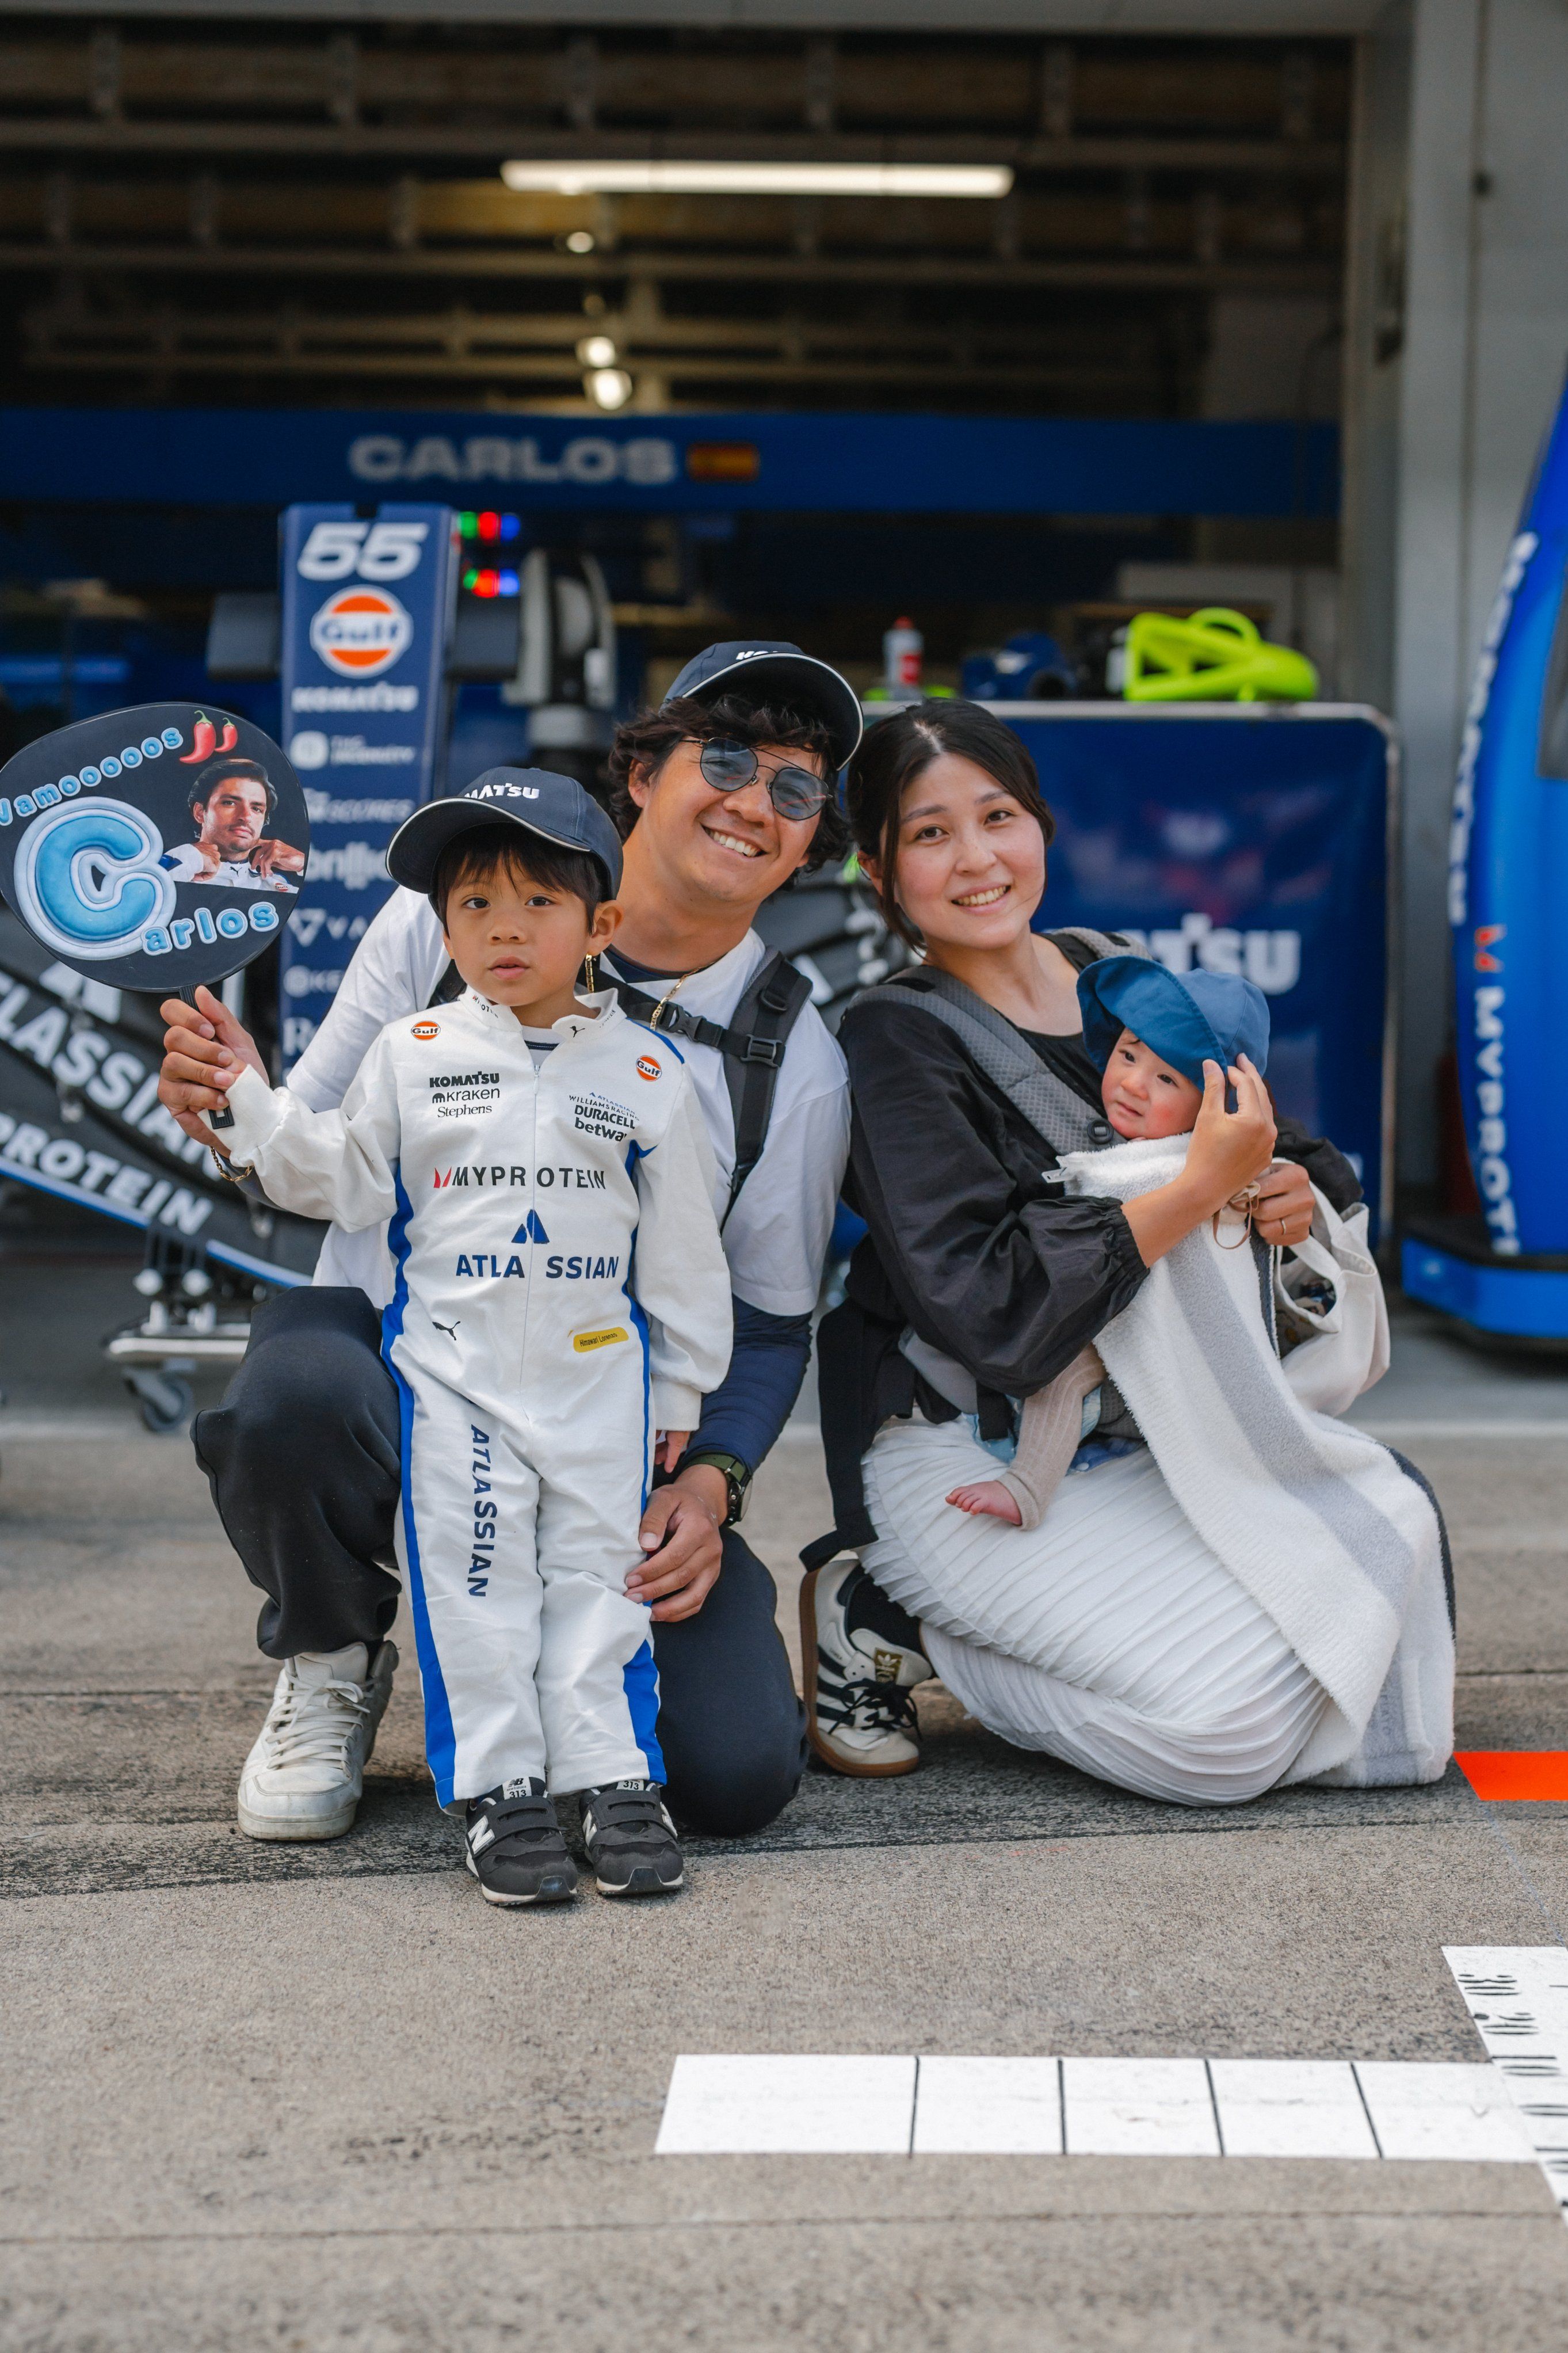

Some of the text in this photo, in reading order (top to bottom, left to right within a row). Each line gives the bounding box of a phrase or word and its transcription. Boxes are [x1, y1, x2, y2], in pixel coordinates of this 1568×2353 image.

[348, 436, 677, 485] CARLOS
[297, 521, 430, 581] 55
[320, 619, 399, 642] Gulf
[1119, 913, 1302, 995] TSU
[429, 1071, 499, 1088] KOMATSU
[637, 1060, 661, 1076] Gulf
[447, 1088, 500, 1102] kraken
[437, 1105, 492, 1117] Stephens
[574, 1105, 635, 1129] DURACELL
[574, 1117, 627, 1142] betwa
[467, 1424, 497, 1597] ATLASSIAN
[509, 1790, 527, 1798] 313
[623, 1780, 639, 1790] 313
